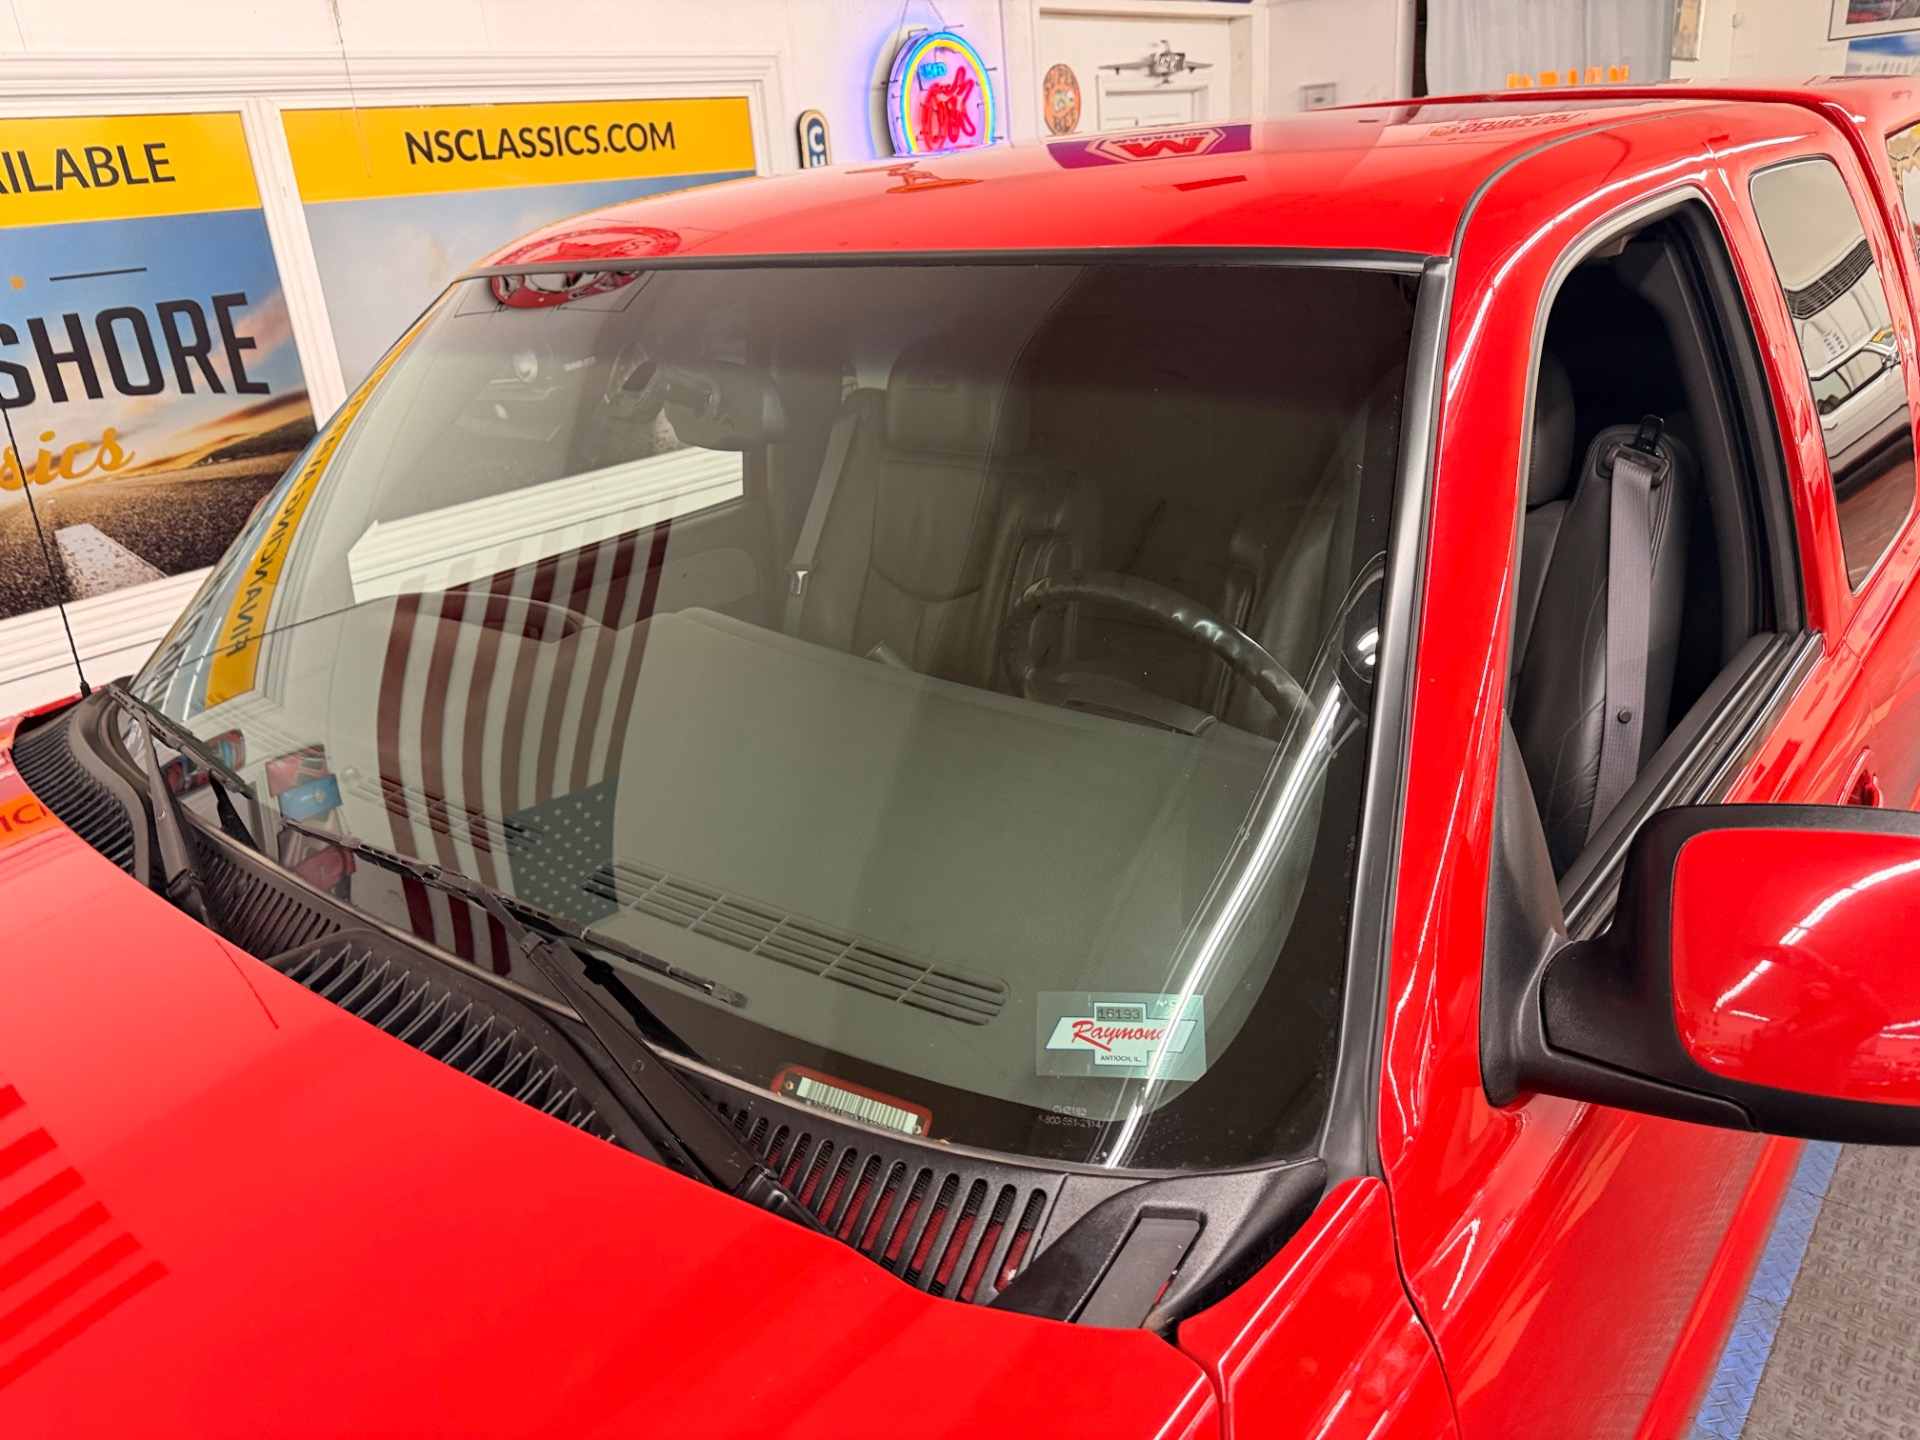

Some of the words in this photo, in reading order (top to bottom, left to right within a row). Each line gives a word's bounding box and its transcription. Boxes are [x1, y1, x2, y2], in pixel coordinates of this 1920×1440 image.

[405, 121, 676, 165] NSCLASSICS.COM
[1097, 1009, 1141, 1020] 16193
[1100, 1054, 1133, 1063] ANTIOCH,
